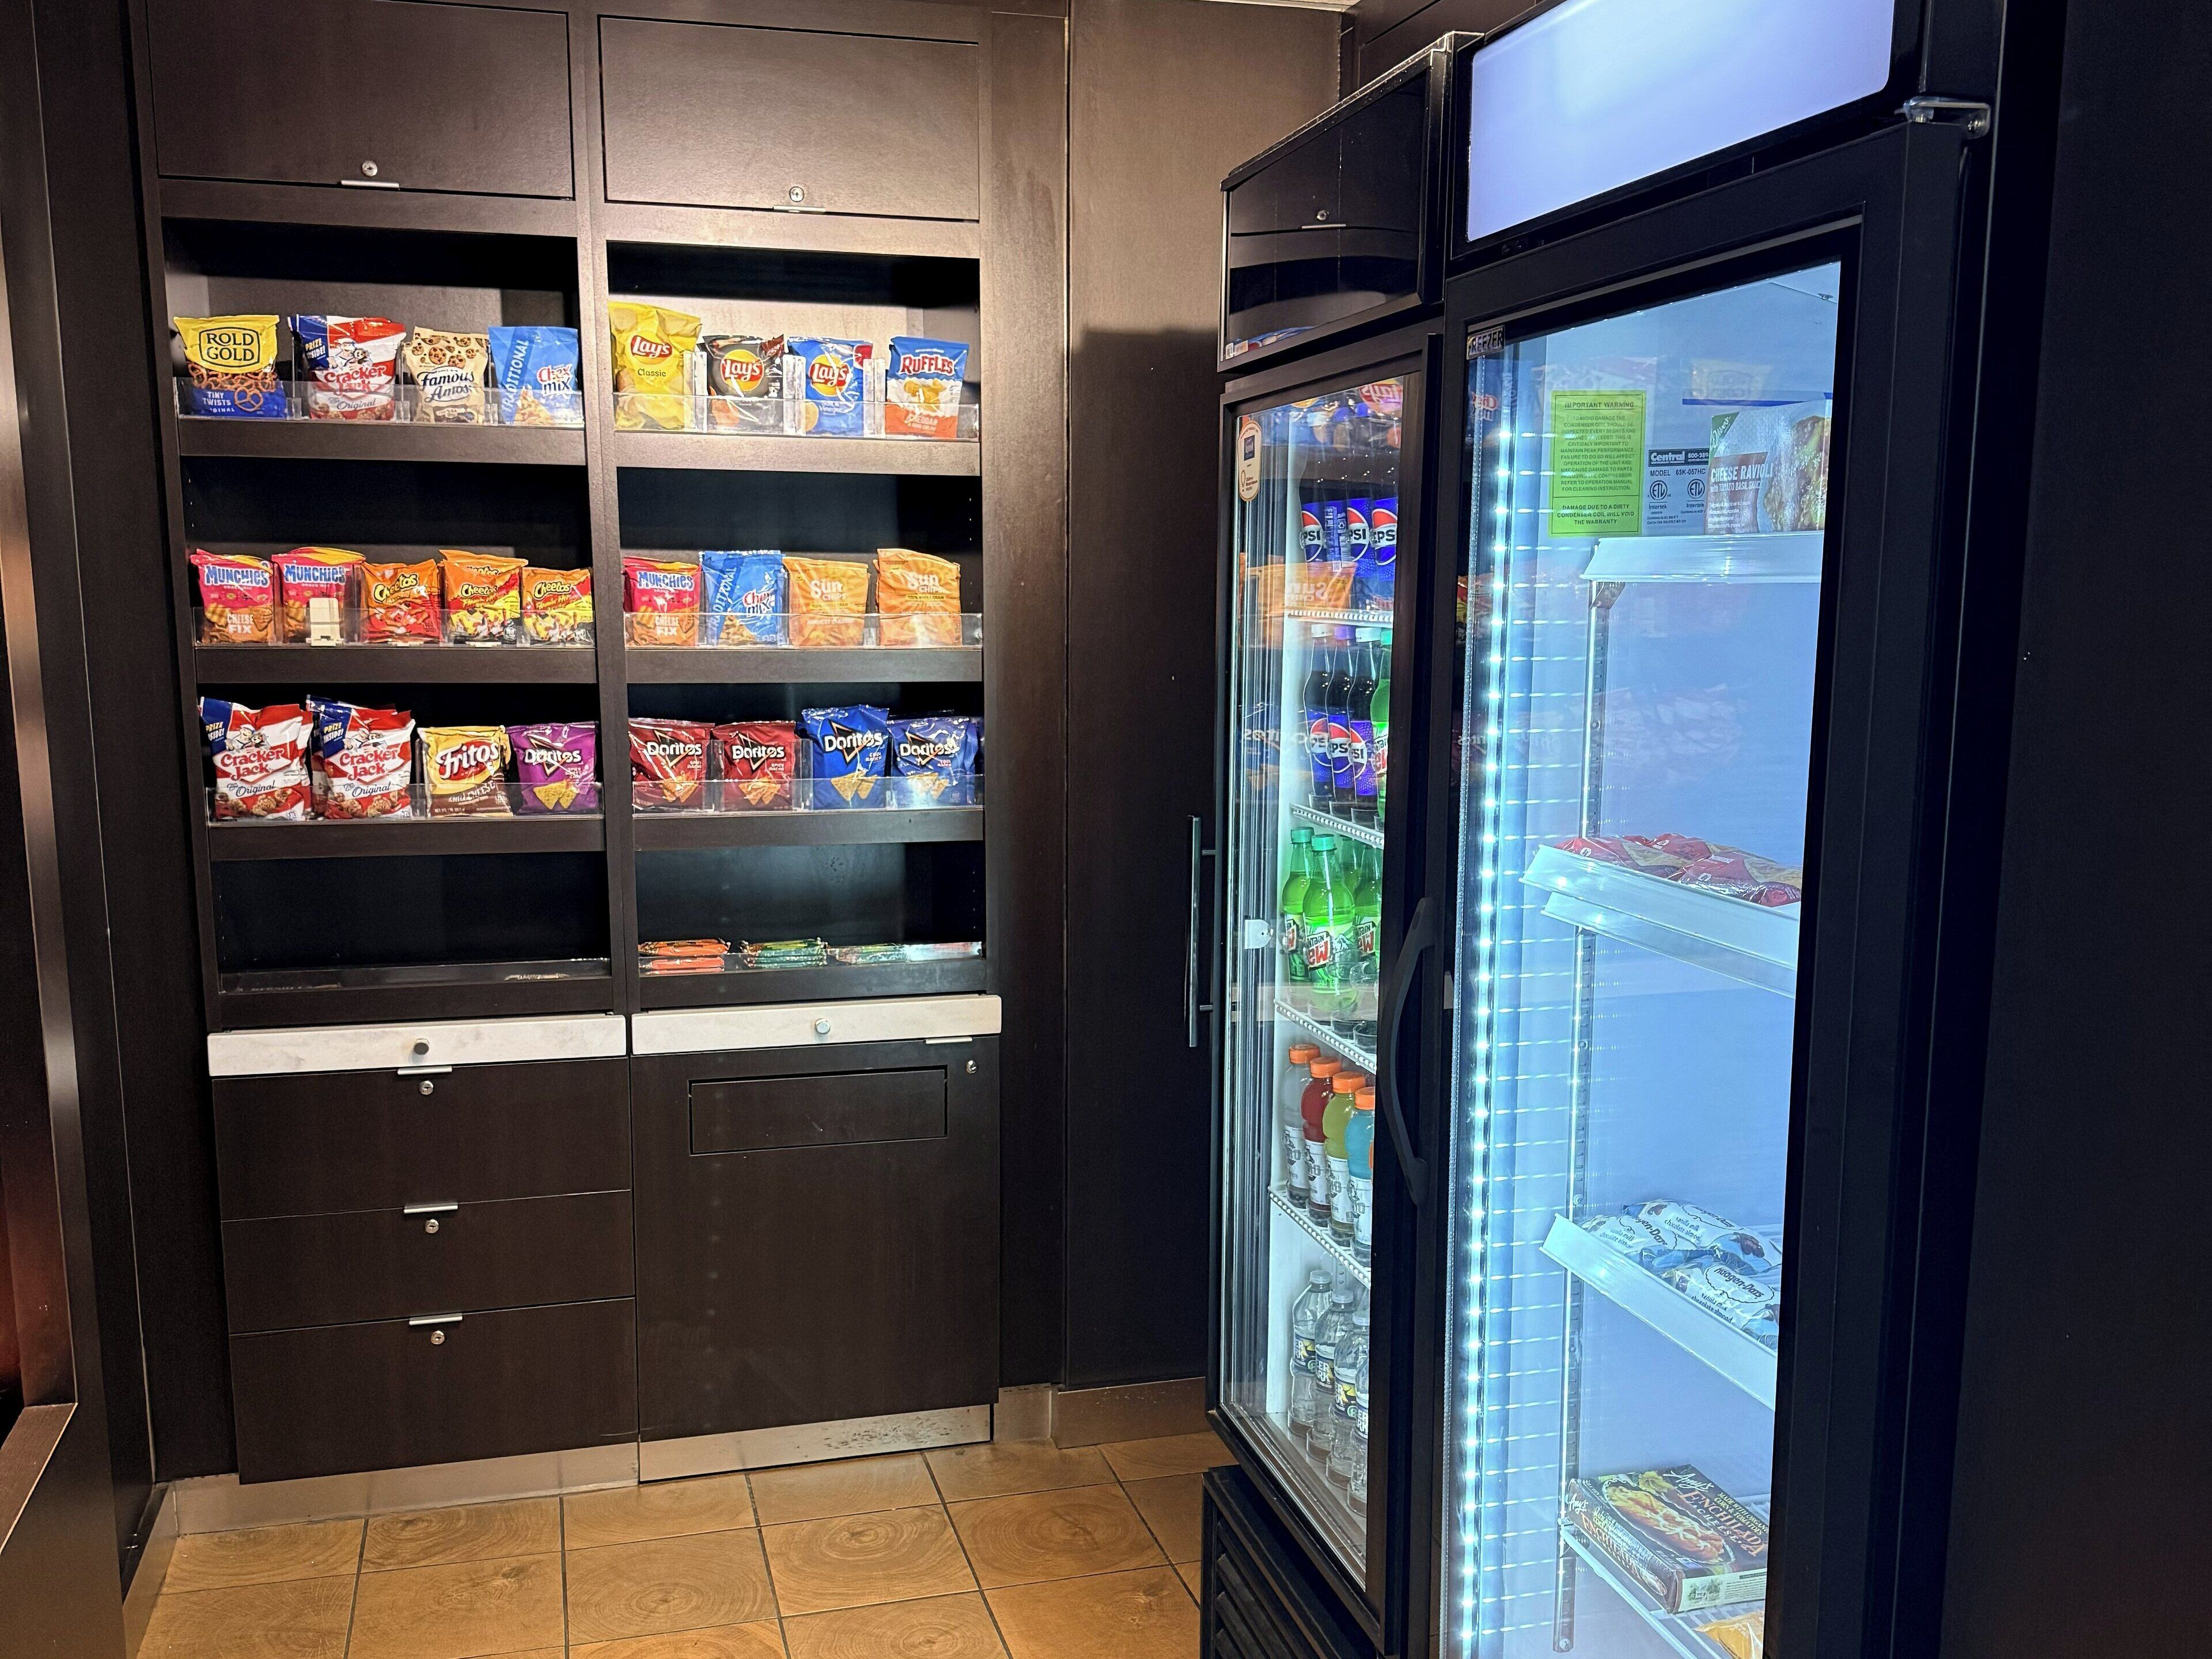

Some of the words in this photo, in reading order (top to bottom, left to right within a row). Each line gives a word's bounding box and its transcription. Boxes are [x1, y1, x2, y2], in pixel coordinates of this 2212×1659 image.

[206, 332, 255, 346] ROLD
[305, 338, 322, 351] PRIZE
[632, 336, 671, 359] Lay's
[206, 346, 255, 361] GOLD
[324, 365, 385, 383] Cracker
[539, 366, 570, 382] Chex
[638, 369, 666, 377] Classic
[724, 358, 763, 381] Lay's
[900, 355, 955, 375] RUFFLES
[416, 372, 474, 391] Famous
[502, 340, 529, 412] TRADITIONAL
[425, 385, 469, 403] Amos
[337, 398, 376, 410] Original
[1651, 451, 1685, 462] Central
[1710, 466, 1739, 483] CHEESE
[1740, 463, 1774, 480] RAVIOLI
[1748, 480, 1761, 489] SAUC
[1304, 530, 1321, 541] PSI
[1349, 528, 1366, 540] PSI
[206, 565, 269, 586] MUNCHIES
[285, 565, 346, 583] MUNCHIES
[638, 571, 694, 590] MUNCHIES
[907, 571, 939, 590] Sun
[374, 573, 418, 602] Cheetos
[534, 581, 570, 599] Cheetos
[810, 579, 843, 600] Sun
[227, 613, 254, 624] CHEESE
[228, 624, 252, 634] FIX
[206, 721, 224, 732] PRIZE
[324, 722, 342, 733] PRIZE
[647, 741, 702, 756] Doritos
[824, 730, 884, 752] Doritos
[900, 742, 954, 757] Doritos
[221, 748, 283, 767] Cracker
[339, 748, 400, 767] Cracker
[435, 742, 499, 779] Fritos
[524, 748, 582, 765] Doritos
[732, 744, 785, 760] Doritos
[232, 762, 271, 781] Jack
[349, 762, 386, 781] Jack
[236, 780, 275, 797] Original
[352, 781, 391, 798] Original
[1663, 1470, 1714, 1493] Amy's
[1569, 1493, 1589, 1514] Amy's
[1714, 1497, 1730, 1510] CORN
[1718, 1492, 1734, 1506] MADE
[1677, 1490, 1767, 1556] ENCHILADA
[1697, 1508, 1738, 1543] CHEESE
